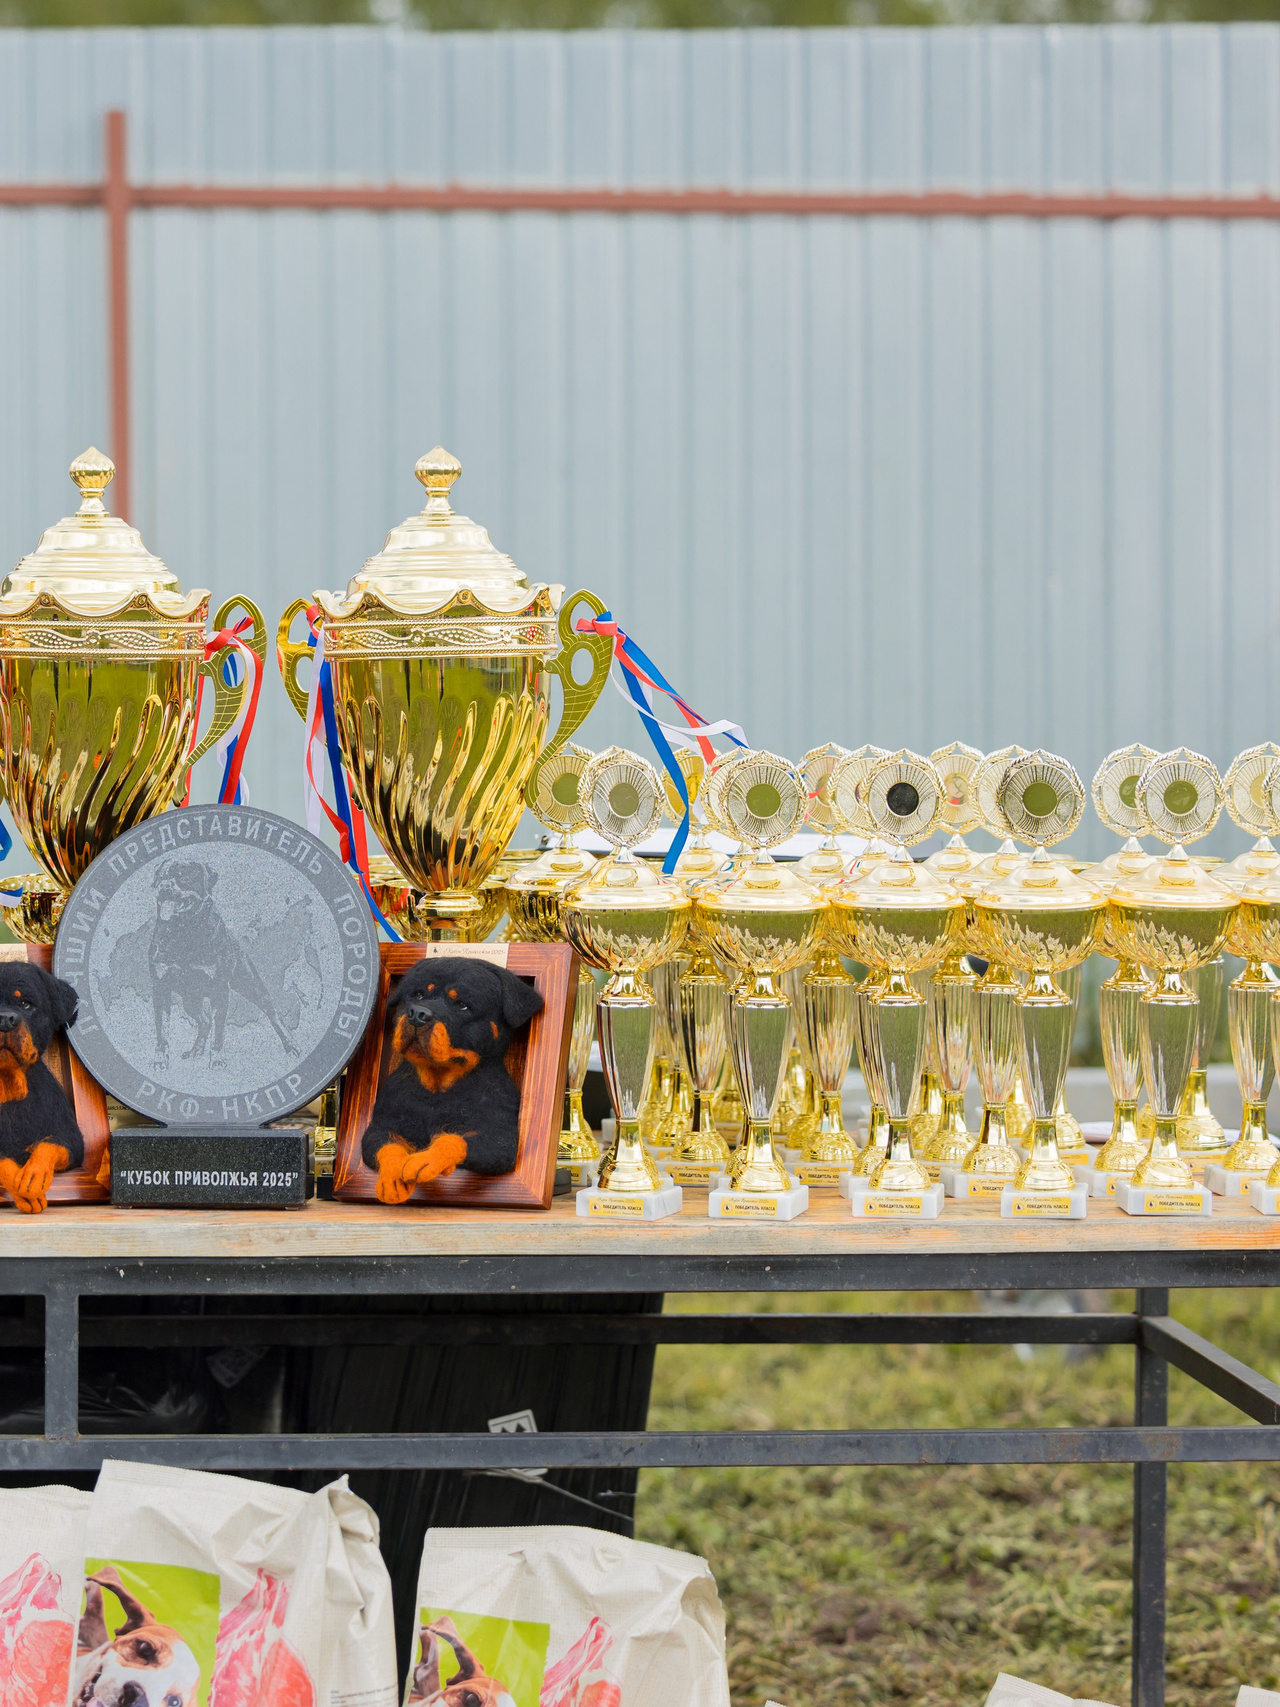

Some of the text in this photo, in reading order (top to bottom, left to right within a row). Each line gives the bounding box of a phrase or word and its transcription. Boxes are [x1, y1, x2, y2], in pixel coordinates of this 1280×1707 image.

[66, 814, 368, 1039] ЛЧШИЙ ПРЕДСТАВИТЕЛЬ ПОРОДЫ
[135, 1073, 302, 1120] РКФ-НКПР
[120, 1170, 299, 1187] “КУБОК ПРИВОЛЖЬЯ 2025”
